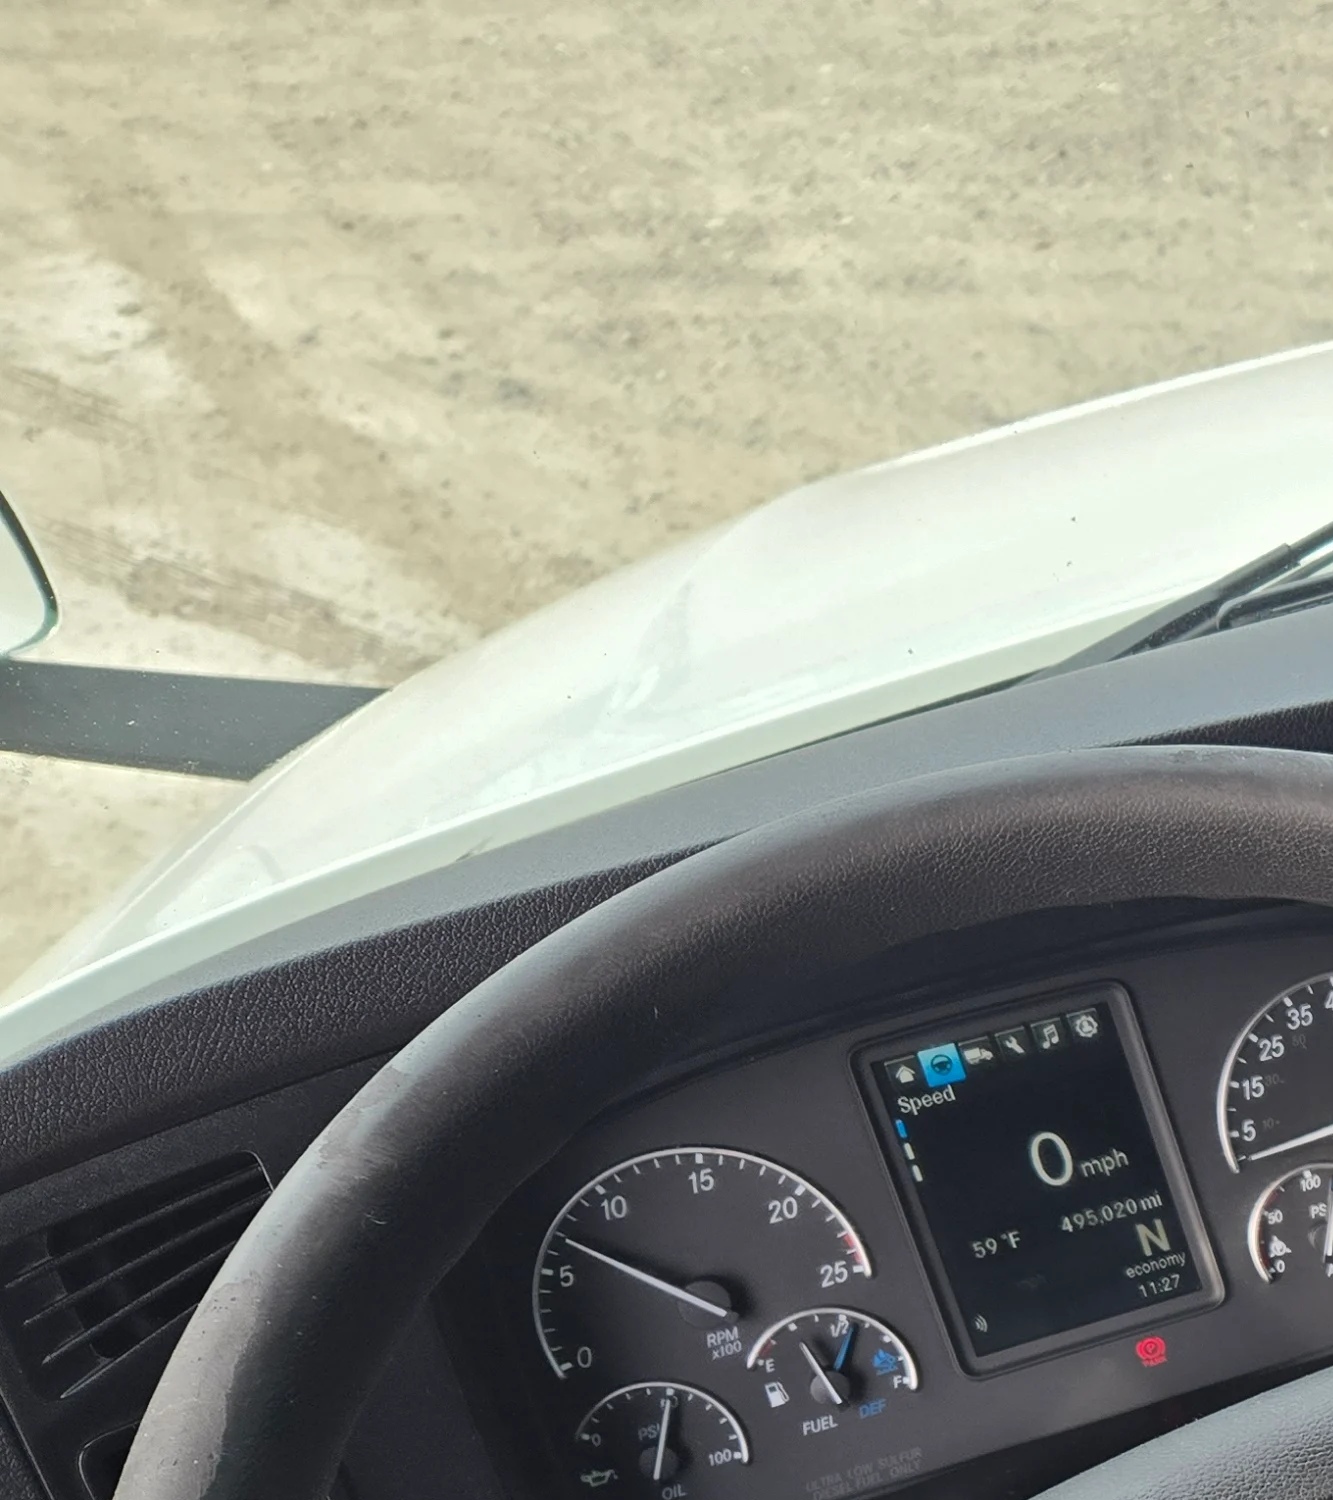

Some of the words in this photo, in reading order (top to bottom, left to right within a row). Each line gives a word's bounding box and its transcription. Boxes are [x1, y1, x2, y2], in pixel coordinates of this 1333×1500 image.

[1286, 1005, 1314, 1030] 35
[1258, 1036, 1285, 1062] 25
[1242, 1076, 1265, 1100] 15
[897, 1085, 956, 1116] Speed
[1242, 1119, 1257, 1141] 5
[1030, 1131, 1073, 1187] 0
[1080, 1149, 1129, 1178] mph
[688, 1169, 715, 1194] 15
[1300, 1175, 1321, 1192] 100
[601, 1196, 628, 1221] 10
[768, 1197, 798, 1224] 20
[1140, 1191, 1163, 1211] mi
[1267, 1209, 1283, 1225] 50
[972, 1239, 997, 1259] 59
[1136, 1219, 1171, 1257] N
[559, 1265, 574, 1287] 5
[820, 1262, 848, 1287] 25
[1126, 1253, 1187, 1279] economy
[1139, 1274, 1181, 1298] 11:27
[707, 1327, 739, 1347] RPM
[576, 1347, 592, 1368] 0
[711, 1340, 743, 1360] x100
[765, 1358, 776, 1373] E
[893, 1375, 903, 1389] F
[859, 1399, 887, 1419] DEF
[802, 1414, 838, 1436] FUEL
[709, 1449, 732, 1466] 100
[662, 1484, 687, 1500] OIL
